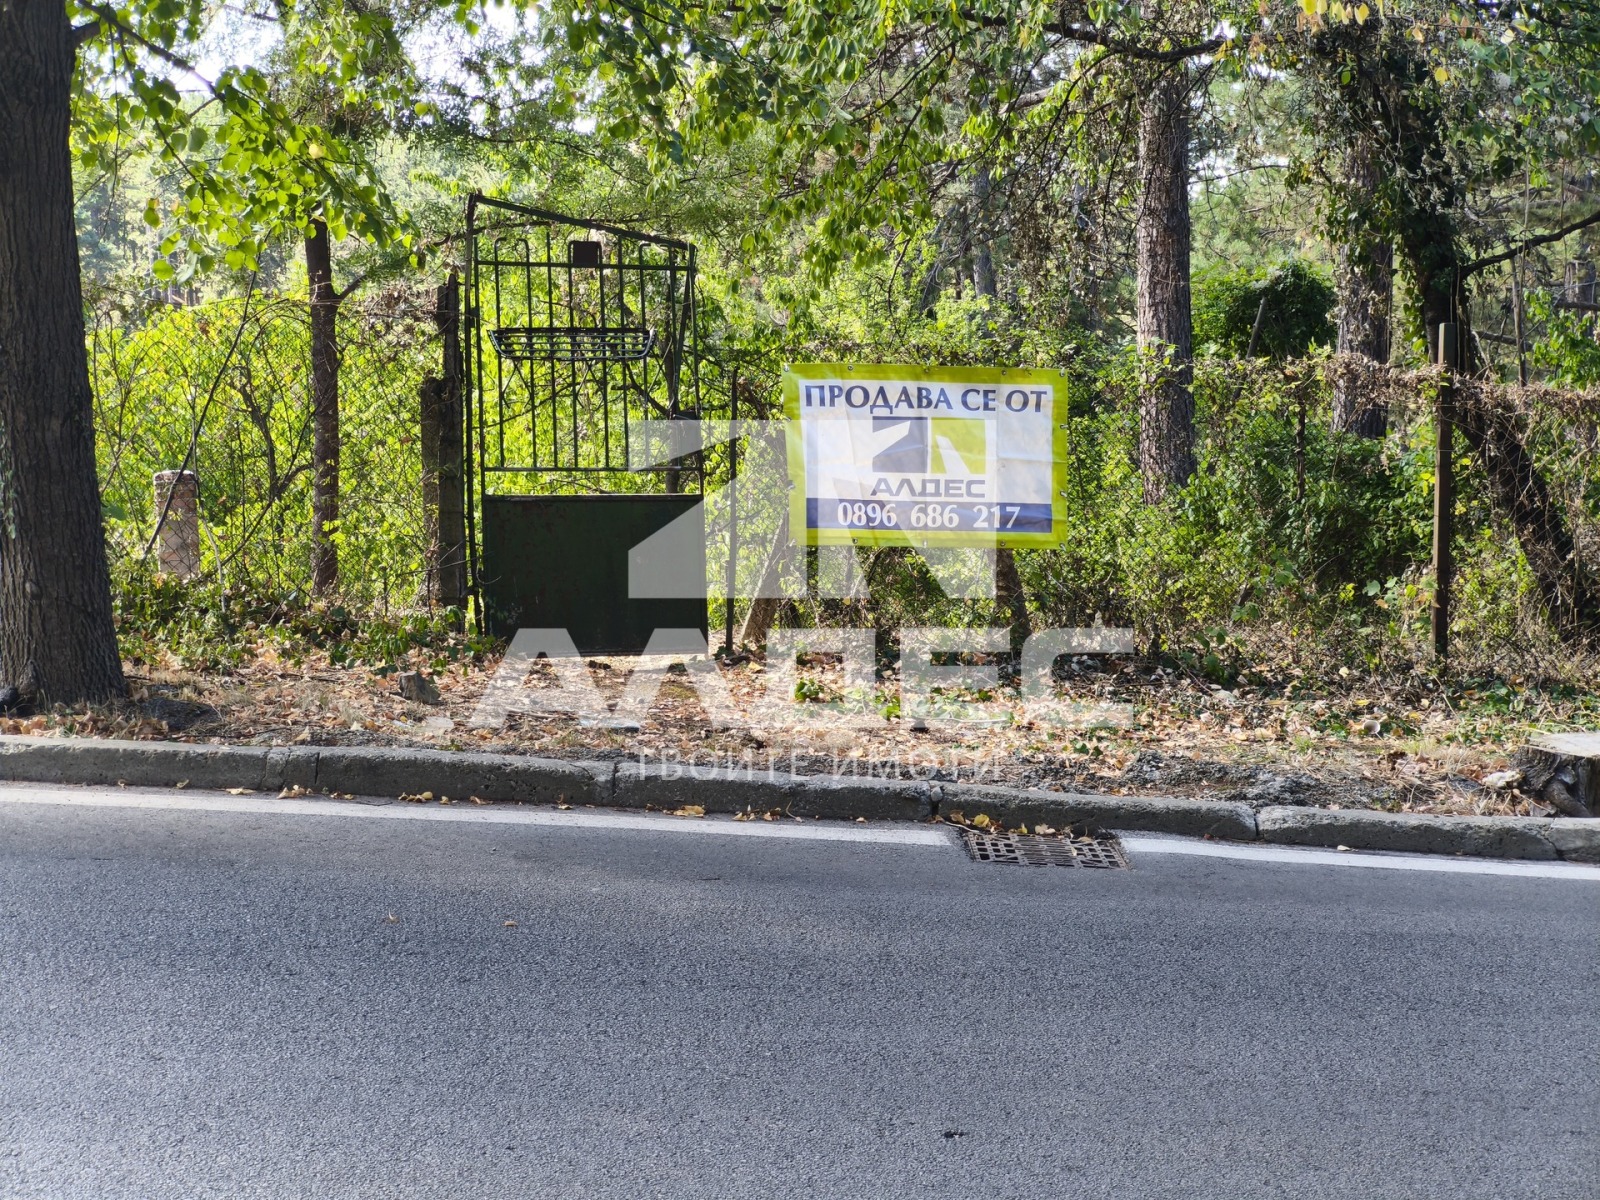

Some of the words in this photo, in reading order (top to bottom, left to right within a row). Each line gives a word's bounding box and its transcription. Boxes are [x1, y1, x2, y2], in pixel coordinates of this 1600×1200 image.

[804, 384, 953, 415] ПРОДАВА
[960, 388, 997, 412] СЕ
[1004, 389, 1047, 413] ОТ
[870, 477, 986, 498] АЛДЕС
[837, 502, 898, 528] 0896
[910, 503, 960, 529] 686
[973, 504, 1021, 530] 217
